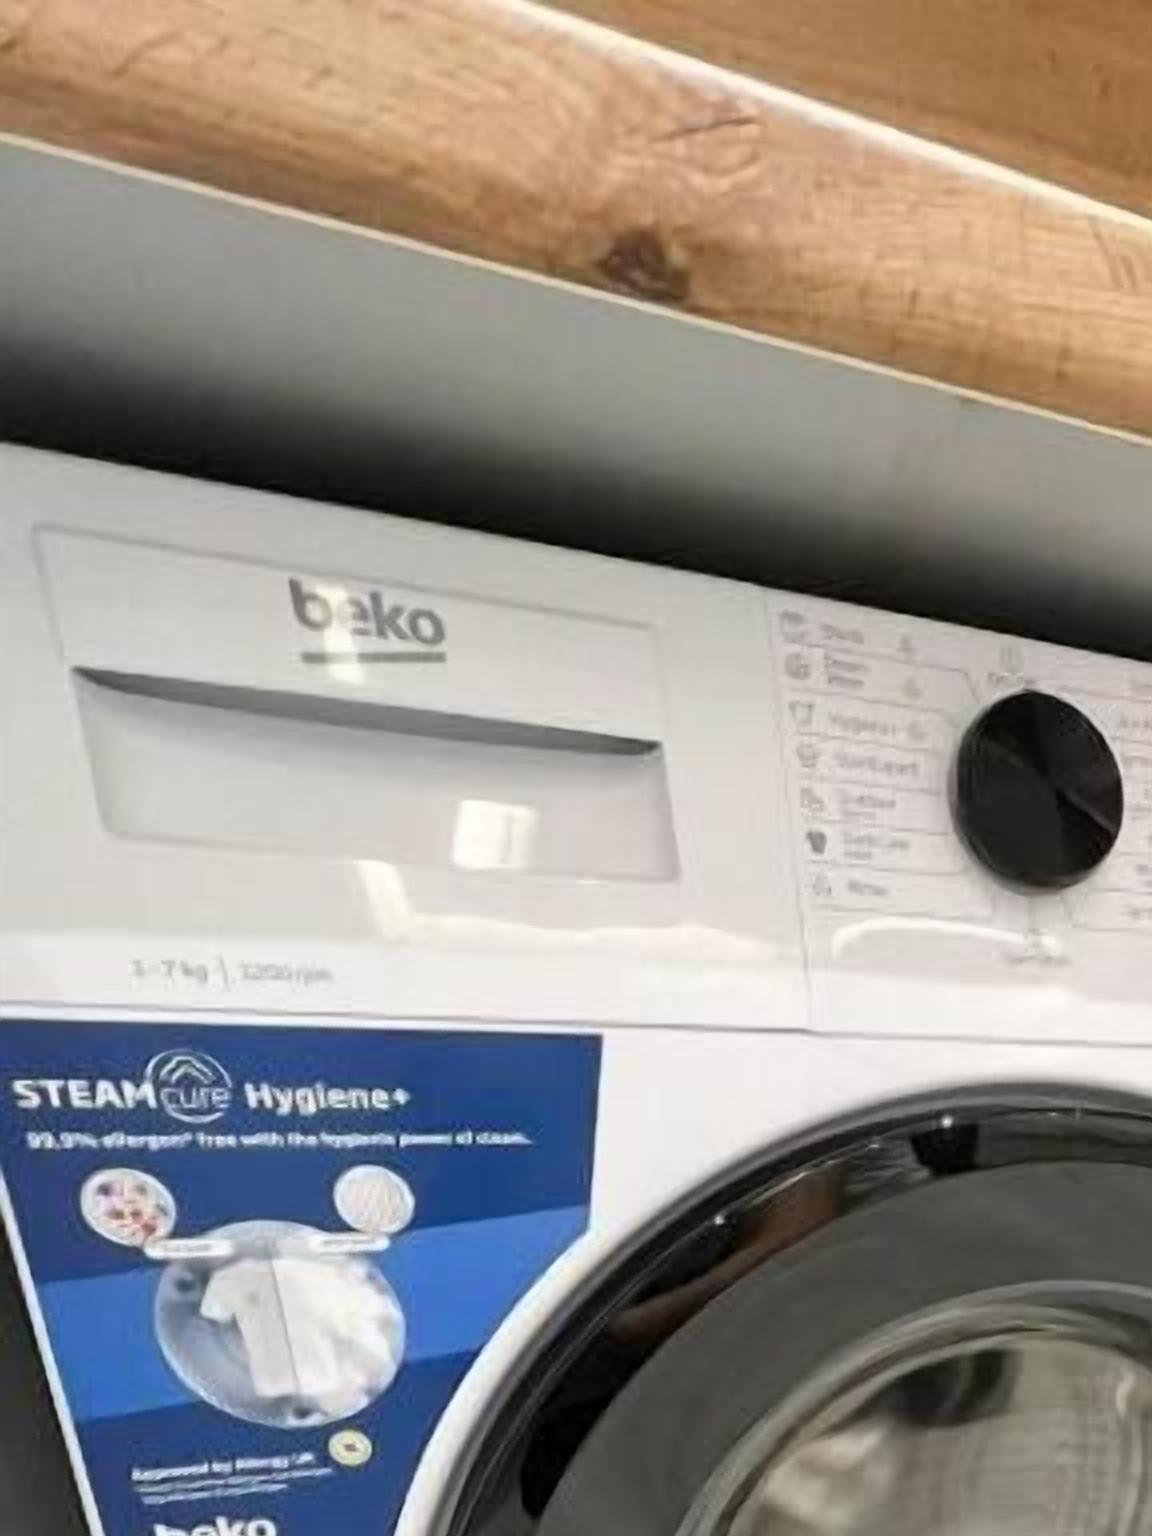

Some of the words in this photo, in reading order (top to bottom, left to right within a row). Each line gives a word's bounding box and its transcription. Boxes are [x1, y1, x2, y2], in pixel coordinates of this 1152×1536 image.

[288, 578, 445, 646] beko
[12, 1079, 158, 1108] STEAM
[244, 1081, 411, 1116] Hygiene+
